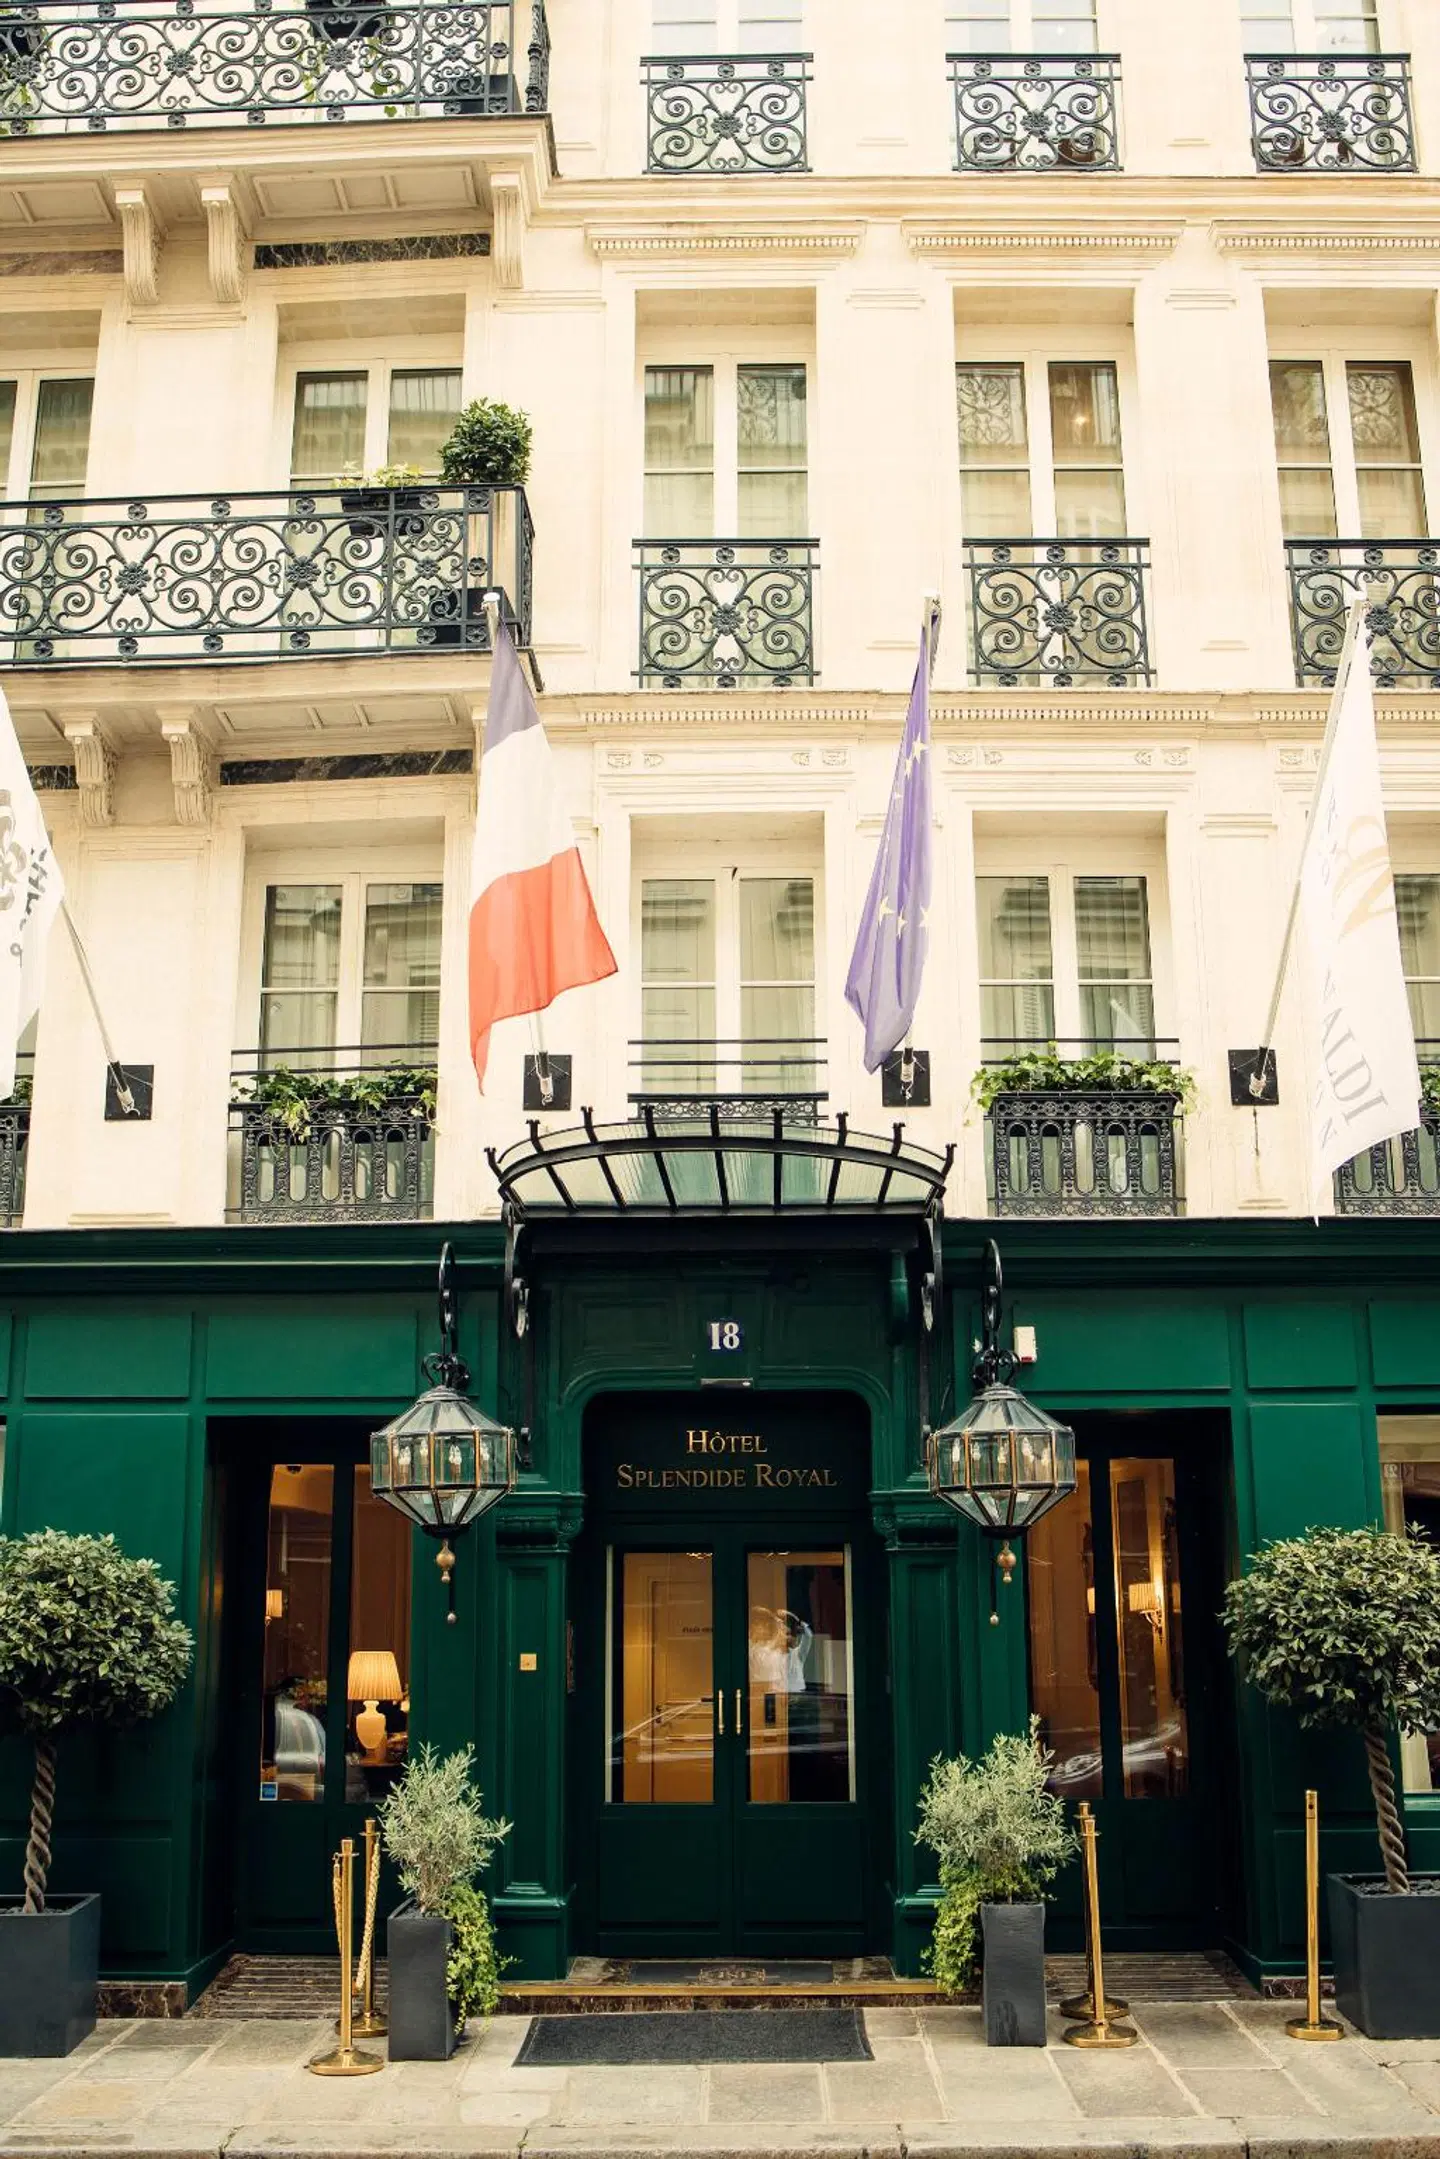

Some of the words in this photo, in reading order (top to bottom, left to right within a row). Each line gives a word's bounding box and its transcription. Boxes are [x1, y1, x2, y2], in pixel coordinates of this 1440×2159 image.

[710, 1322, 740, 1350] 18
[617, 1463, 746, 1488] SPLENDIDE
[754, 1463, 838, 1488] ROYAL
